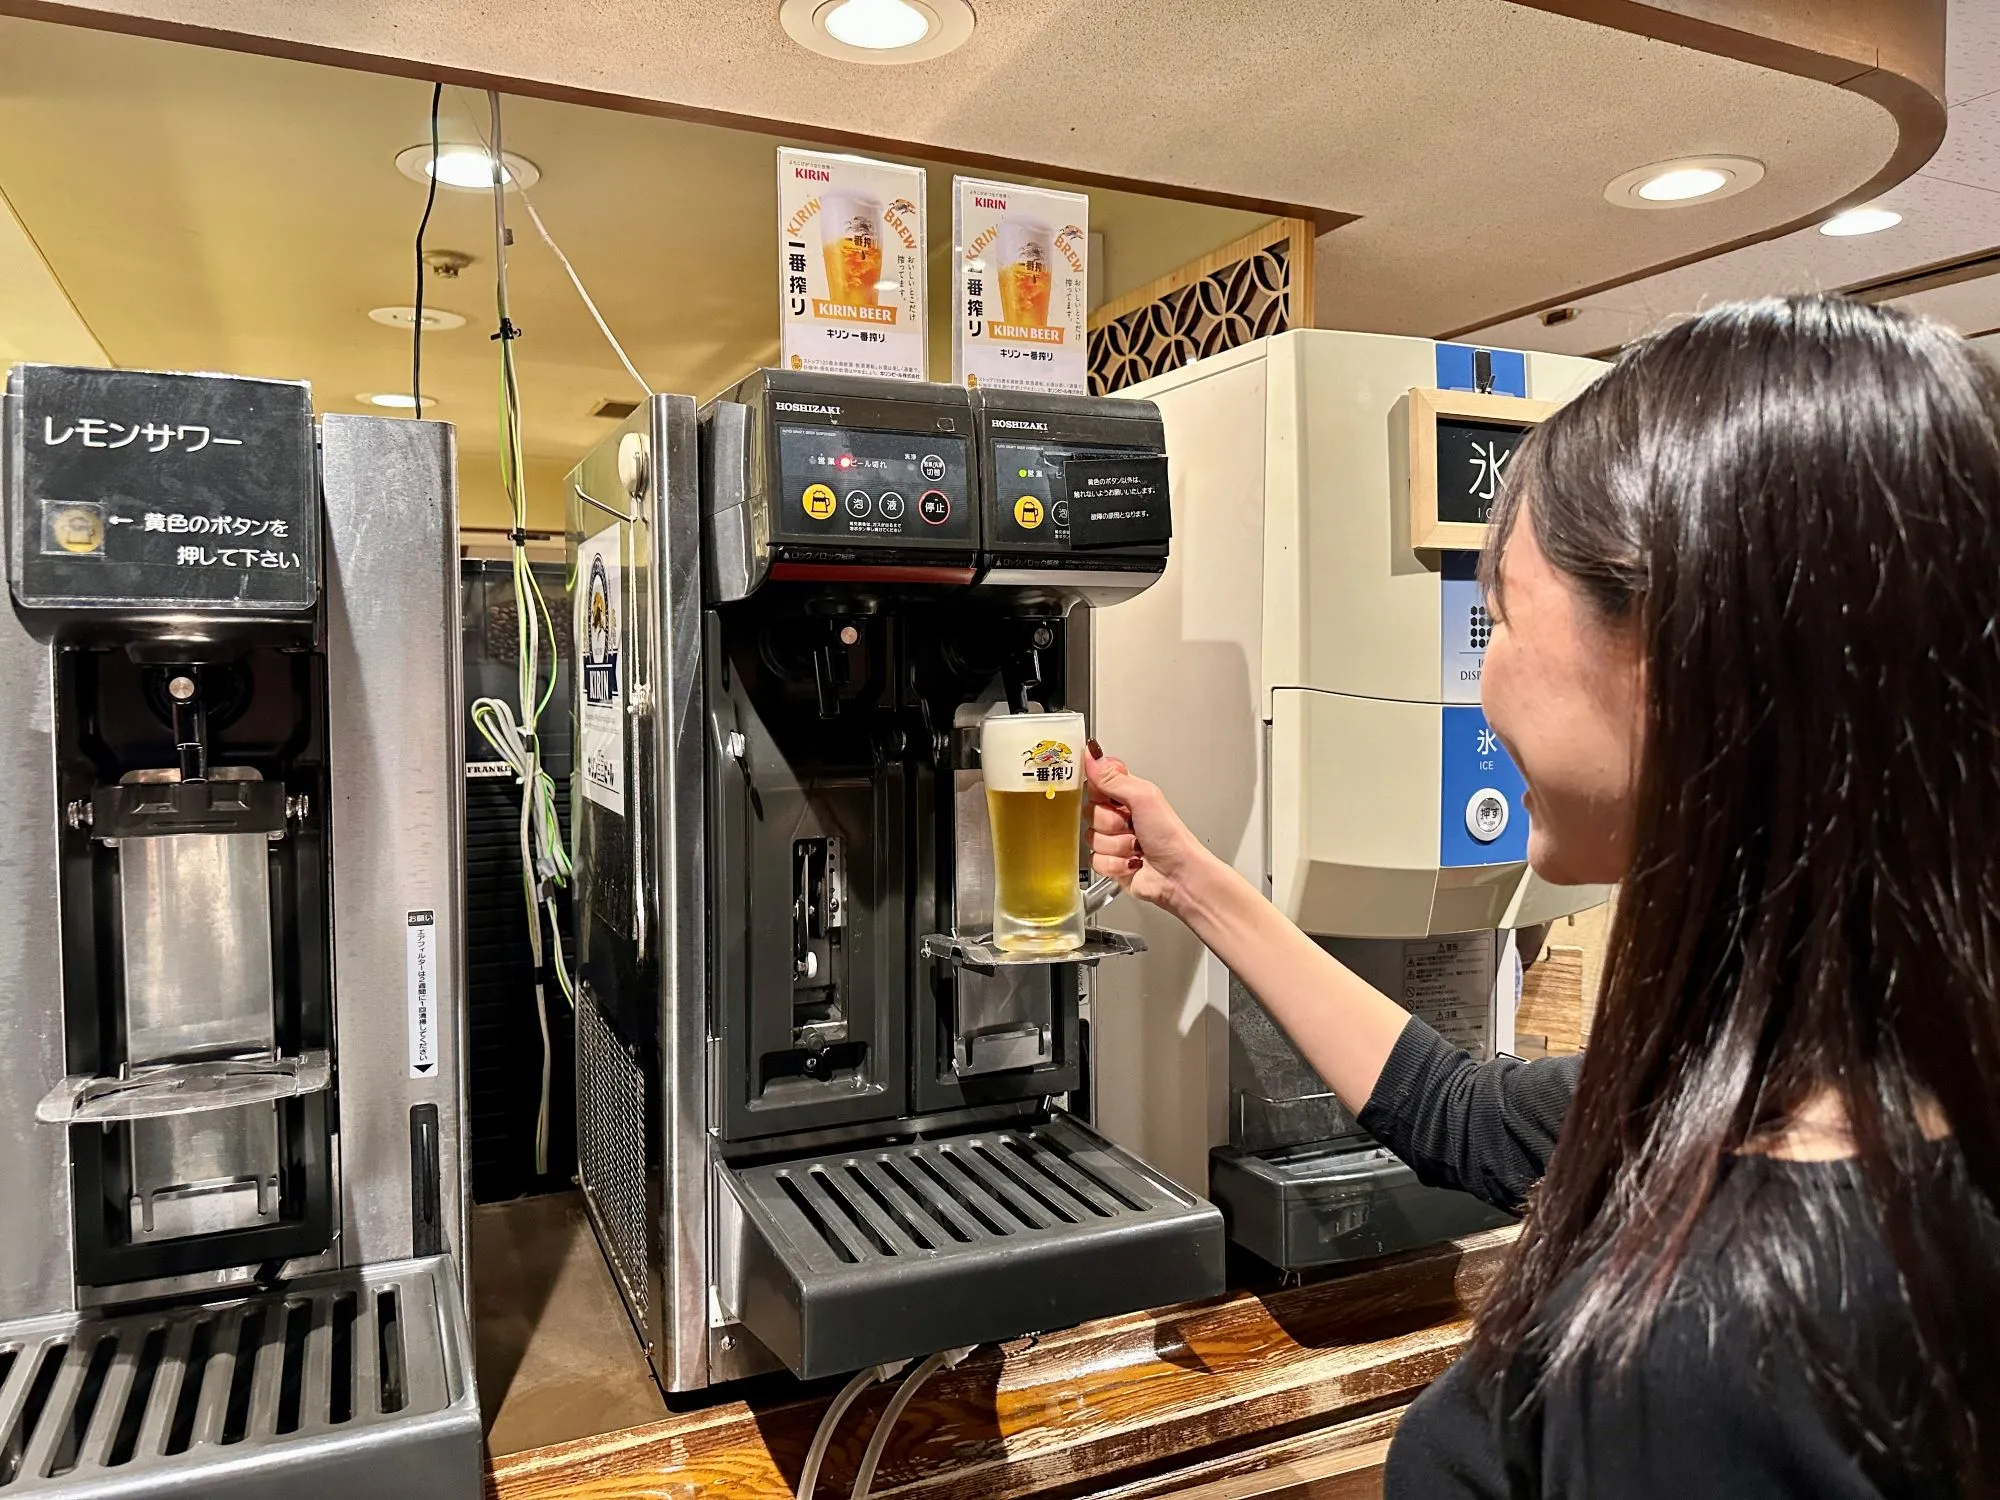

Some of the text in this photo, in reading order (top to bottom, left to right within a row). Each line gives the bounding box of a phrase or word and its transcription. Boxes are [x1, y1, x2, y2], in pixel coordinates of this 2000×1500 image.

[795, 167, 830, 182] KIRIN
[975, 197, 1006, 210] KIRIN
[787, 197, 821, 237] KIRIN
[883, 209, 917, 250] BREW
[966, 226, 998, 261] KIRIN
[1054, 235, 1084, 273] BREW
[788, 241, 806, 316] 一番搾り
[819, 303, 892, 322] KIRIN BEER
[994, 325, 1060, 341] KIRIN BEER
[776, 402, 840, 415] HOSHIZAKI
[992, 420, 1048, 431] HOSHIZAKI
[44, 416, 243, 452] レモンサワー
[850, 460, 888, 469] ビール切れ
[1469, 441, 1510, 499] 氷
[852, 498, 864, 510] 泡
[886, 499, 897, 511] 液
[925, 501, 945, 514] 停止
[144, 513, 289, 537] 黄色のボタンを
[177, 546, 300, 569] 押して下さい
[589, 669, 609, 700] KIRIN
[1476, 728, 1498, 755] 氷
[1479, 760, 1494, 770] ICE
[1022, 766, 1074, 781] 一番搾り
[1480, 807, 1500, 820] 押す
[408, 914, 433, 924] お願い
